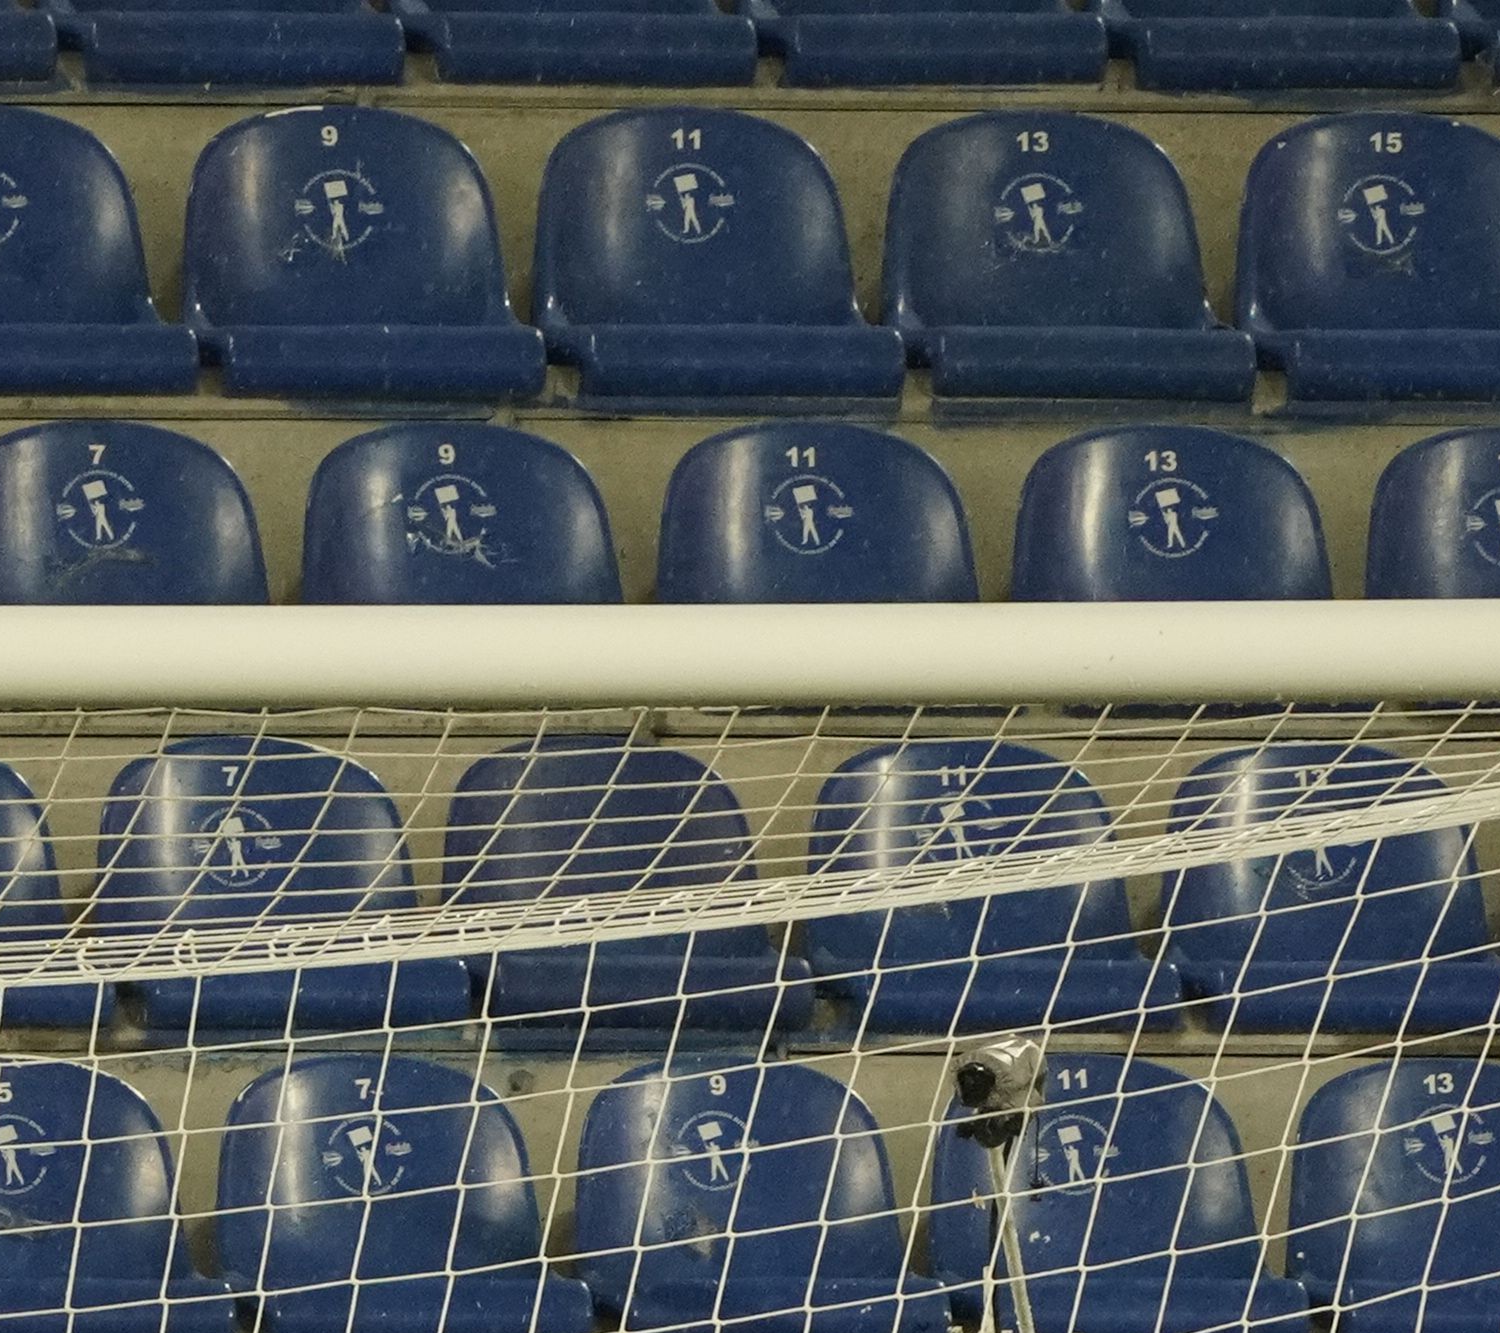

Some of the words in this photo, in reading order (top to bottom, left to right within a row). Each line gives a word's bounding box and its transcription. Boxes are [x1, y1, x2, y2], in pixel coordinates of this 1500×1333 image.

[320, 125, 338, 147] 9
[671, 128, 701, 150] 11
[1016, 131, 1049, 152] 13
[1369, 131, 1403, 153] 15
[88, 444, 106, 465] 7
[438, 443, 456, 465] 9
[785, 446, 815, 468] 11
[1144, 450, 1178, 472] 13
[222, 766, 239, 787] 7
[355, 1078, 372, 1100] 7
[709, 1075, 727, 1096] 9
[1057, 1069, 1088, 1090] 11
[1423, 1073, 1455, 1094] 13
